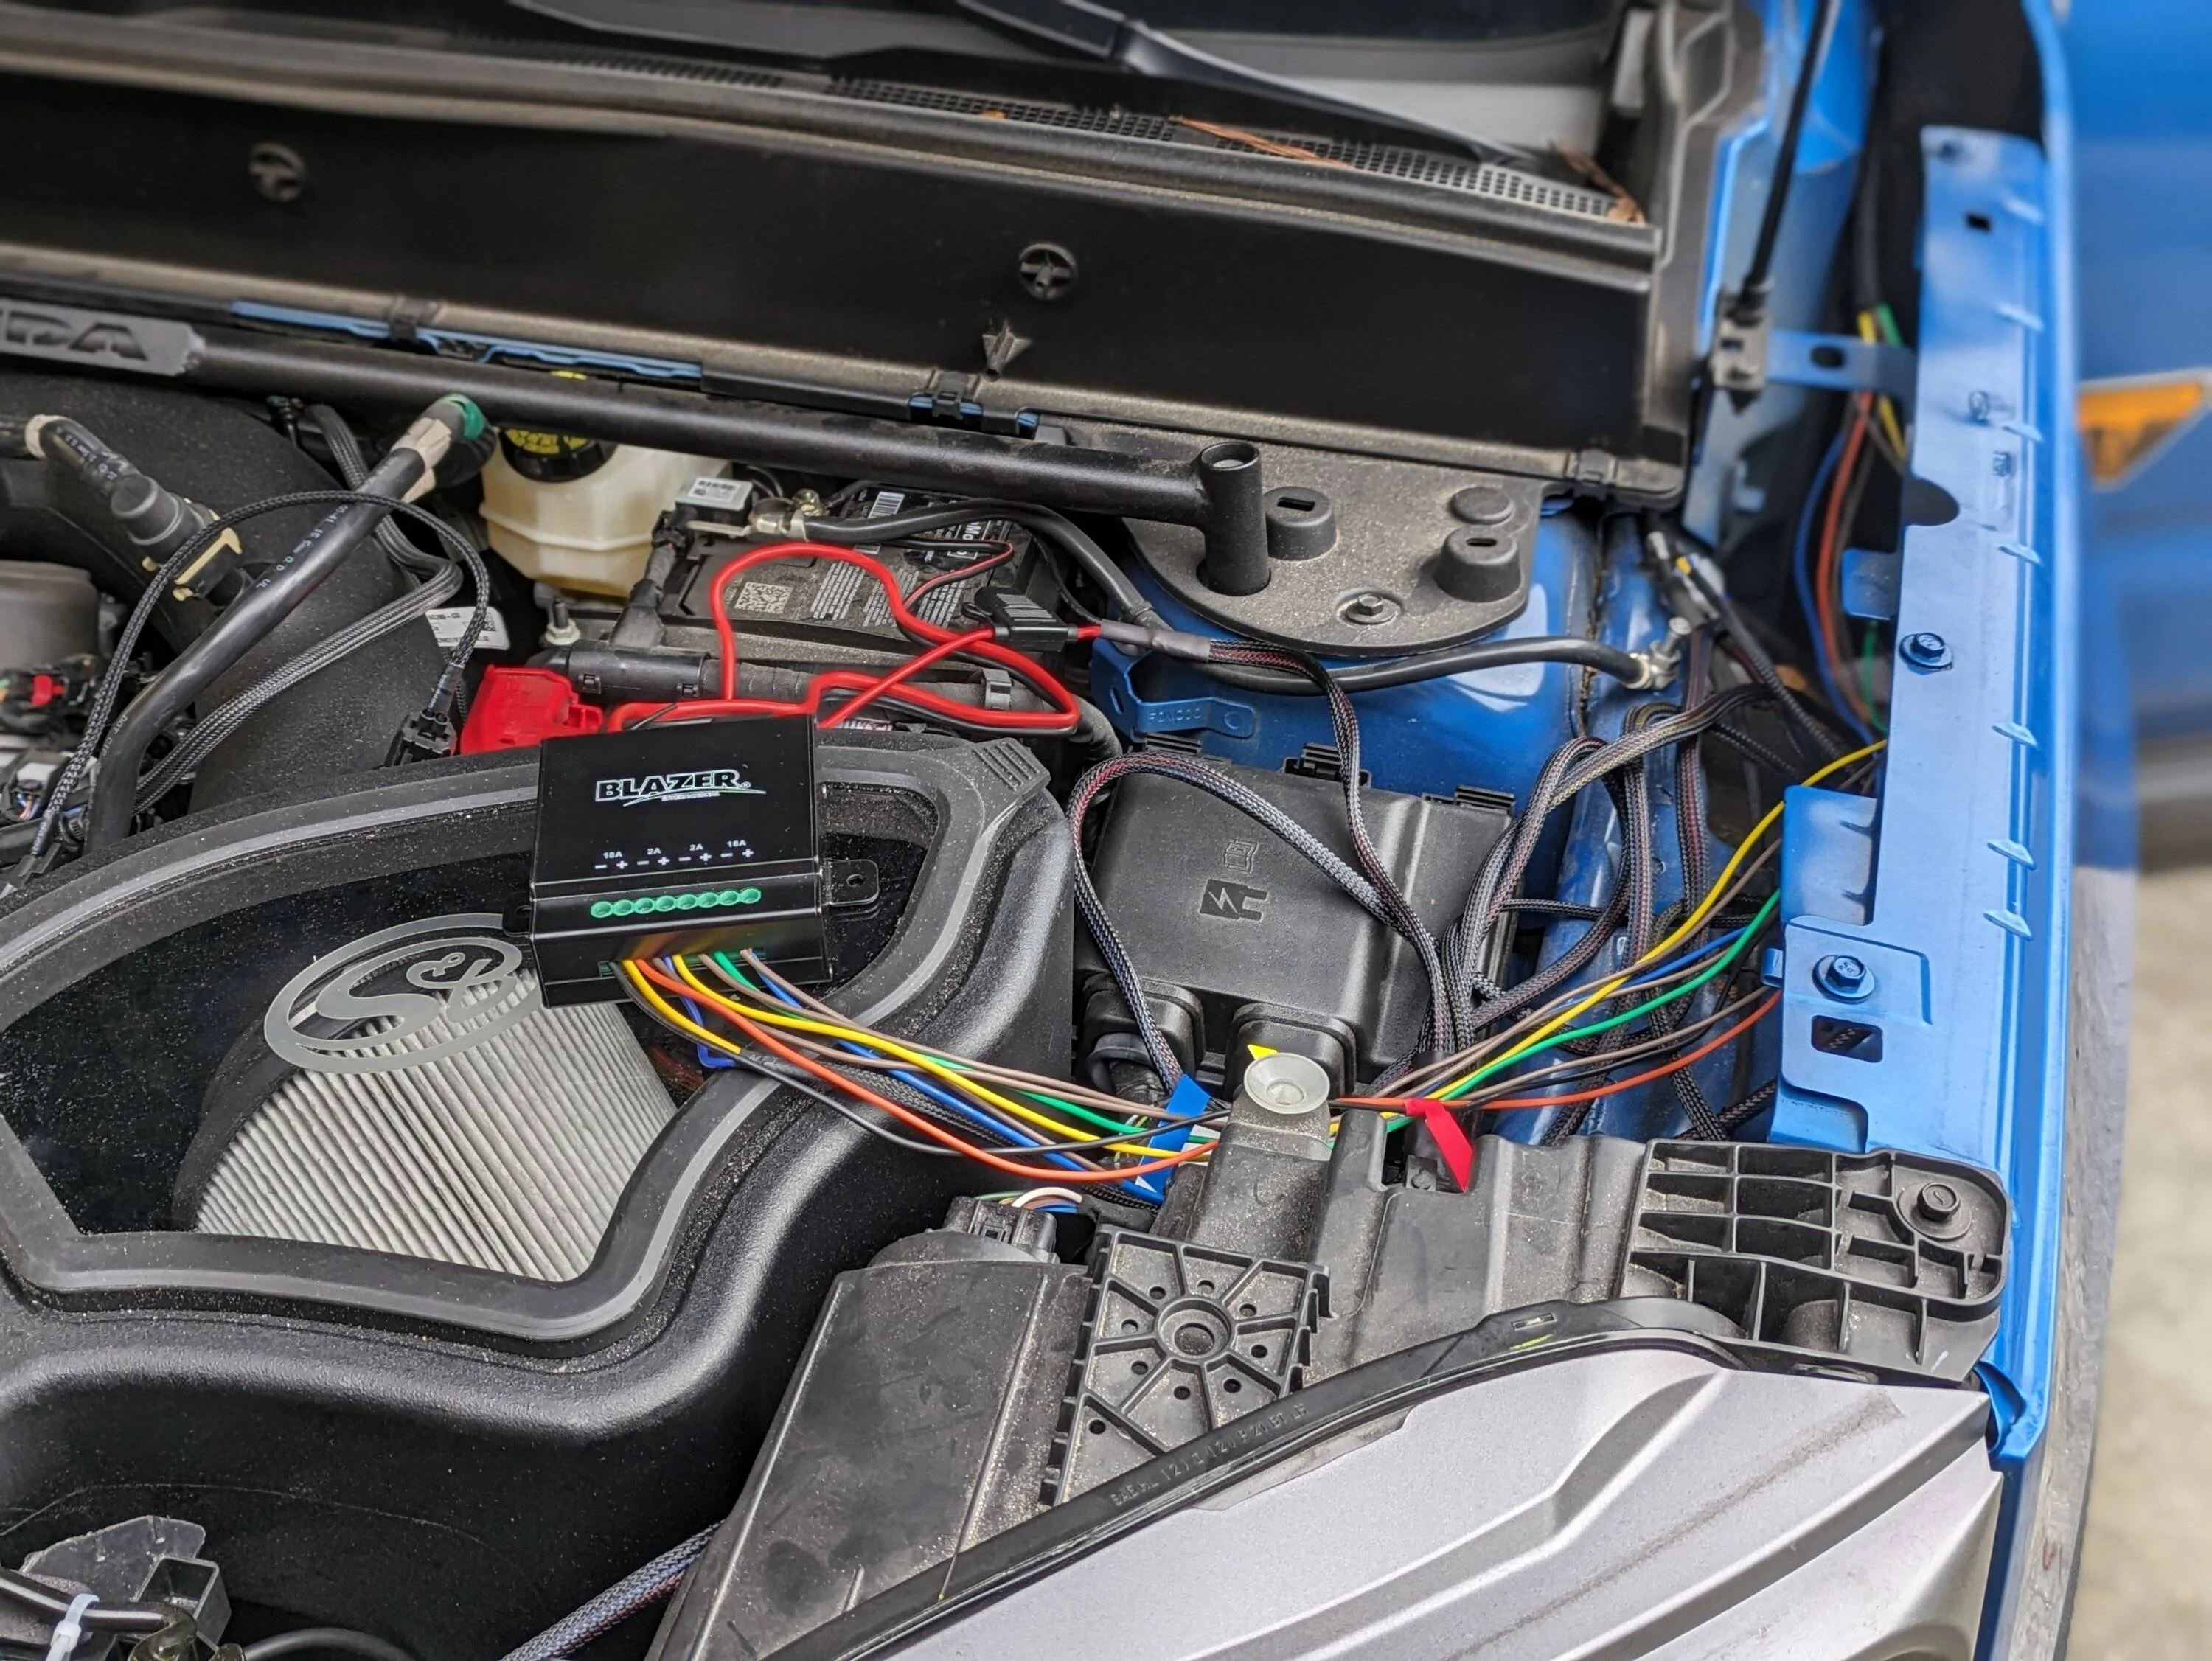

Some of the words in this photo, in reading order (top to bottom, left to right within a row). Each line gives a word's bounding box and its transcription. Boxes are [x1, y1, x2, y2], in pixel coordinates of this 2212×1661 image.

[594, 769, 740, 802] BLAZER
[602, 851, 623, 860] 18A
[647, 847, 662, 856] 2A
[689, 843, 704, 852] 2A
[726, 839, 747, 849] 18A
